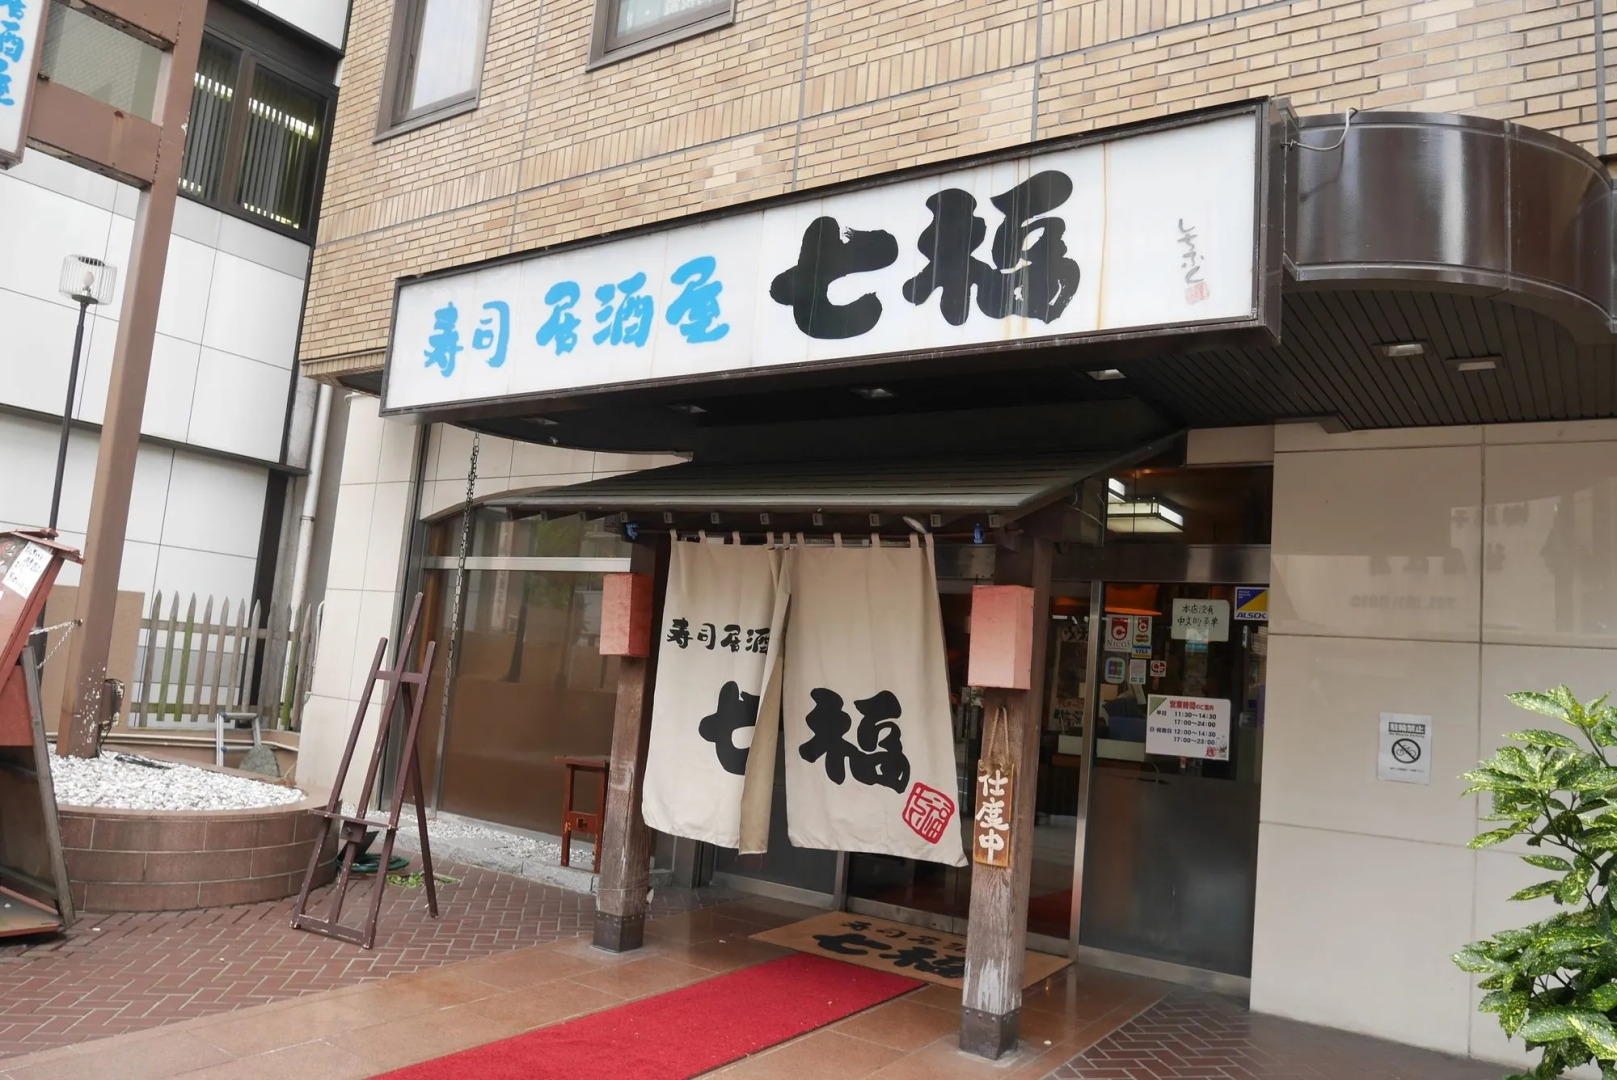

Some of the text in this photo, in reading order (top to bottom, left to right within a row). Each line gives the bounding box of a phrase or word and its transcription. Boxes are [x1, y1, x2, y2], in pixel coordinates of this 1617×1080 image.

[423, 170, 1082, 377] 寿司 居酒屋 七福
[1177, 218, 1205, 284] しちふく
[1169, 700, 1215, 711] 営業時間のご案内
[975, 771, 1010, 862] 仕度中
